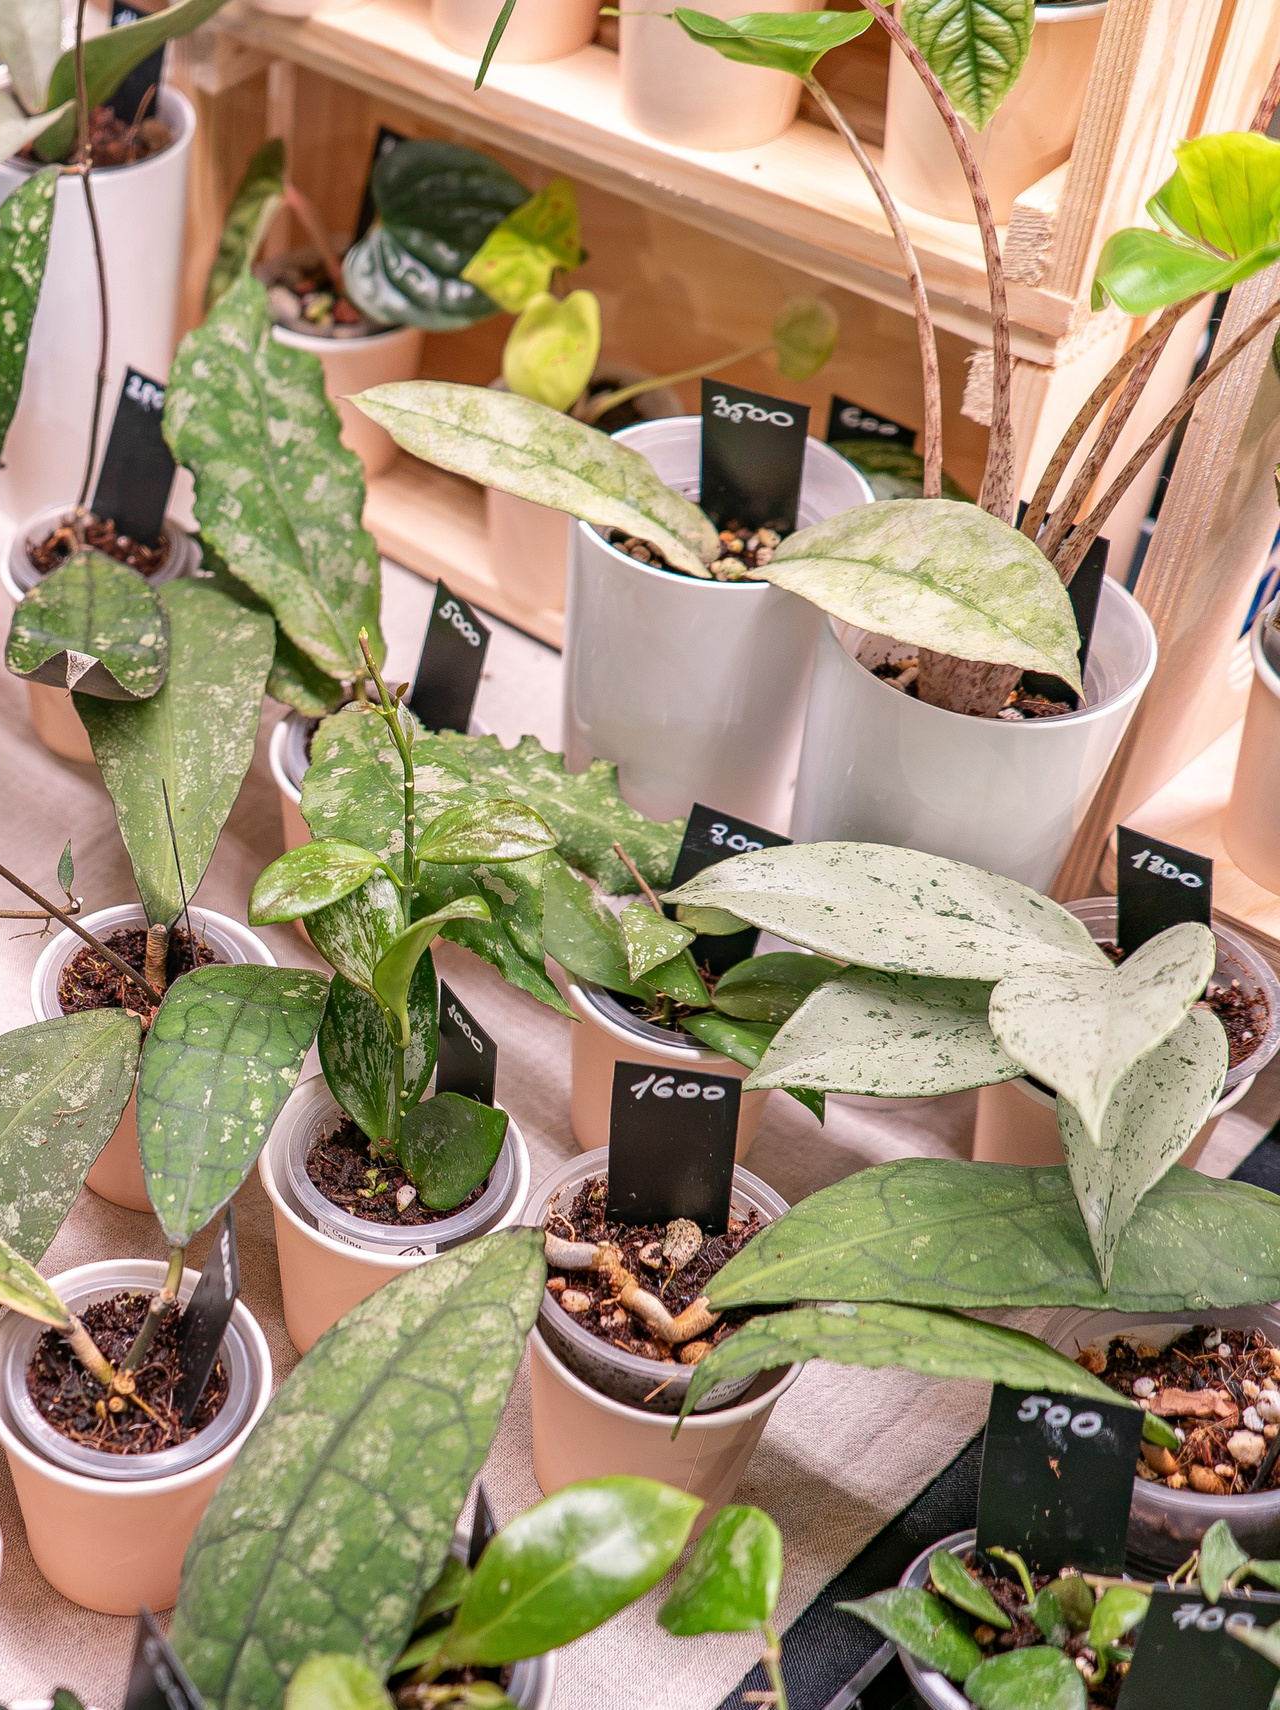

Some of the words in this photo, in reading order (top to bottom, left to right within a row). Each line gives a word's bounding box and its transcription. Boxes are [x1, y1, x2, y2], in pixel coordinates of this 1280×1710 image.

[438, 599, 481, 647] 5000
[448, 1003, 483, 1053] 1000
[630, 1075, 725, 1101] 1600
[332, 1228, 363, 1250] Colina
[1017, 1395, 1103, 1438] 500
